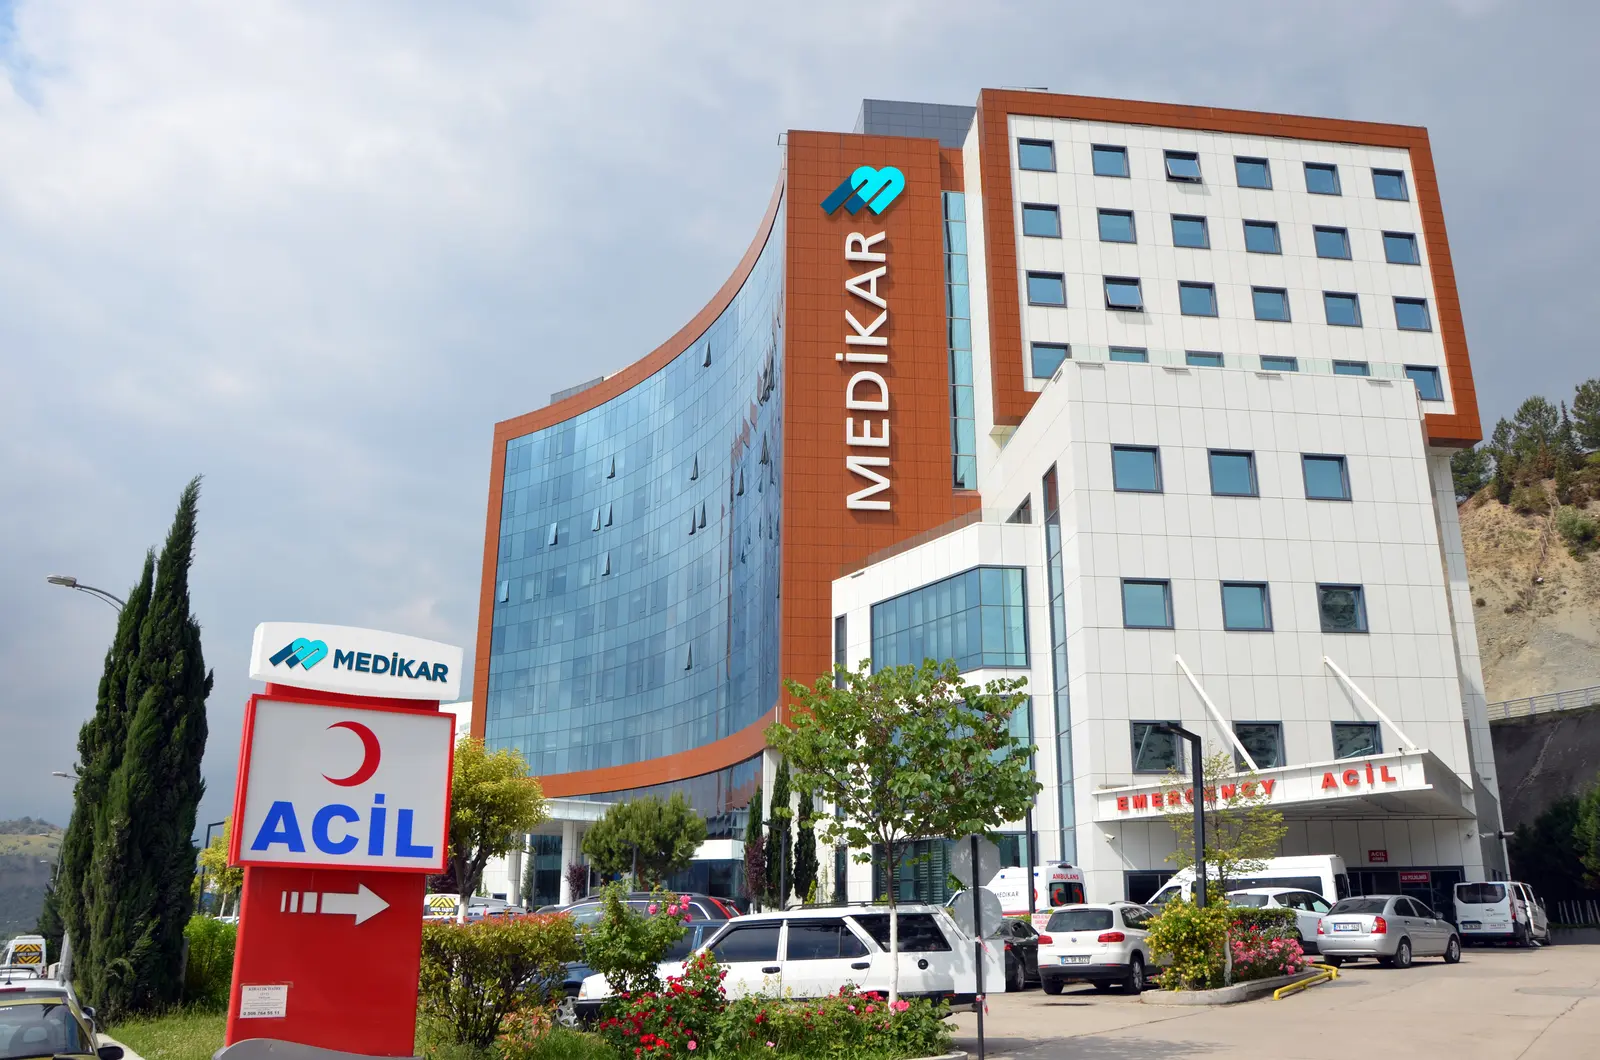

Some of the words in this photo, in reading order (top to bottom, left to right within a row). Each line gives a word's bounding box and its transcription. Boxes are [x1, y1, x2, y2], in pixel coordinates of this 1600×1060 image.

[835, 230, 891, 511] MEDİKAR
[333, 648, 449, 683] MEDİKAR
[1321, 762, 1397, 789] ACİL
[250, 793, 434, 859] ACİL
